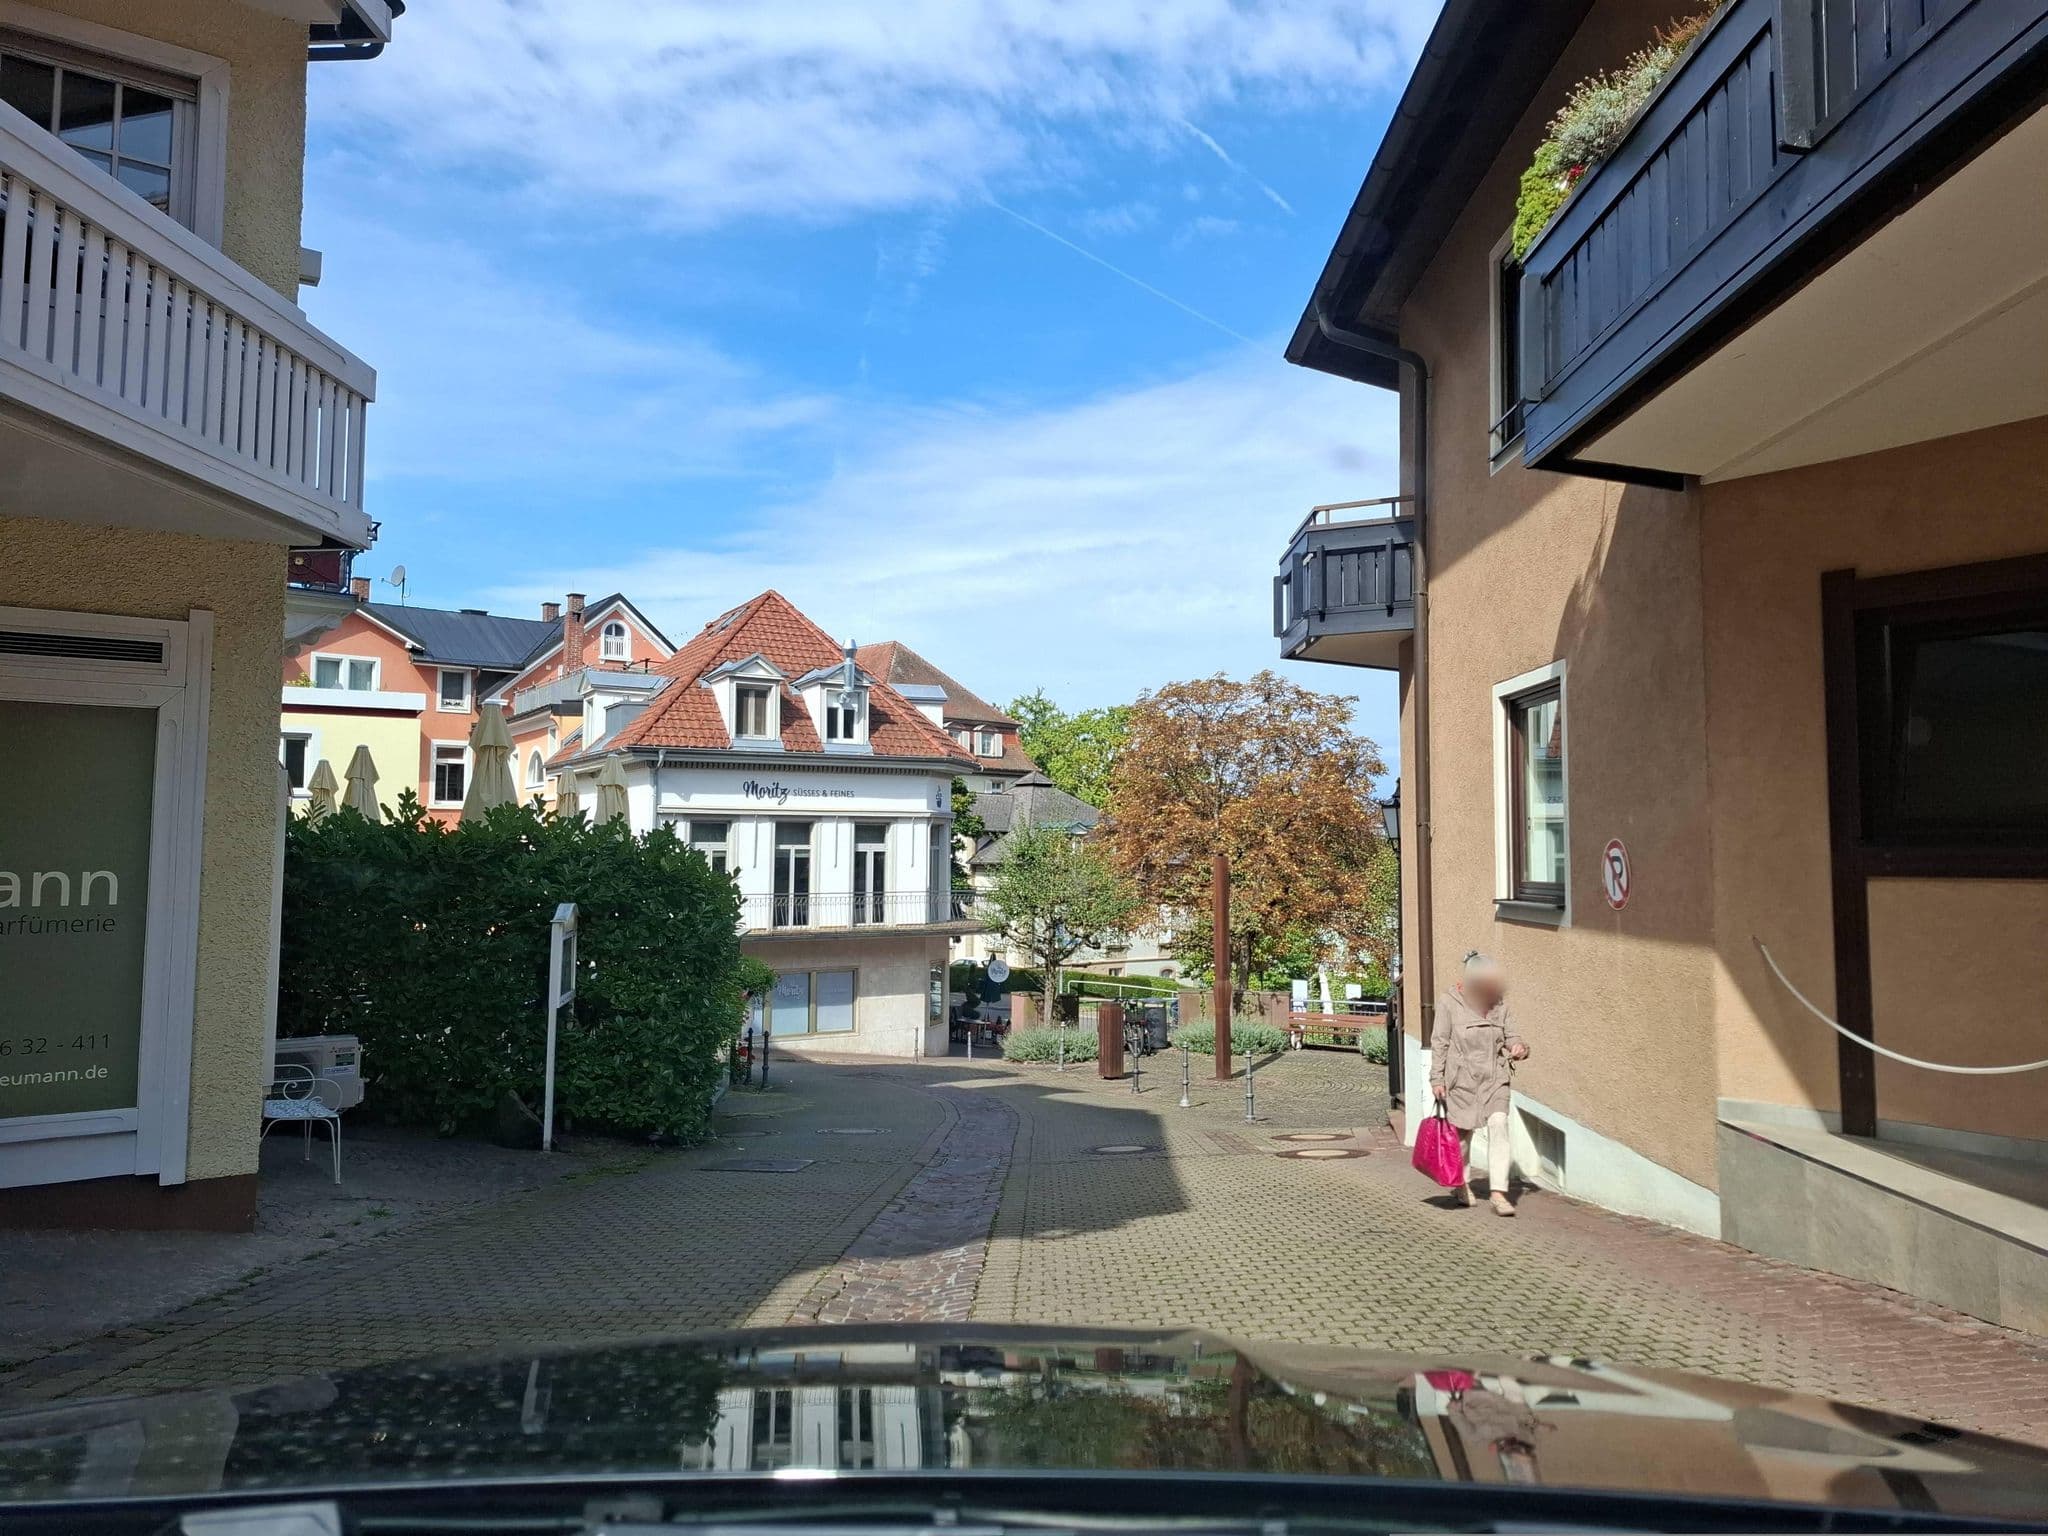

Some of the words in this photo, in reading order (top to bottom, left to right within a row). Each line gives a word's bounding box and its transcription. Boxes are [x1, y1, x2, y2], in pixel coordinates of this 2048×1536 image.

[742, 780, 790, 805] Moritz
[793, 788, 820, 797] SÜSSES
[822, 789, 828, 797] &
[830, 790, 855, 798] FEINES
[20, 1037, 48, 1055] 32
[71, 1033, 109, 1051] 411
[0, 1064, 108, 1087] eumann.de
